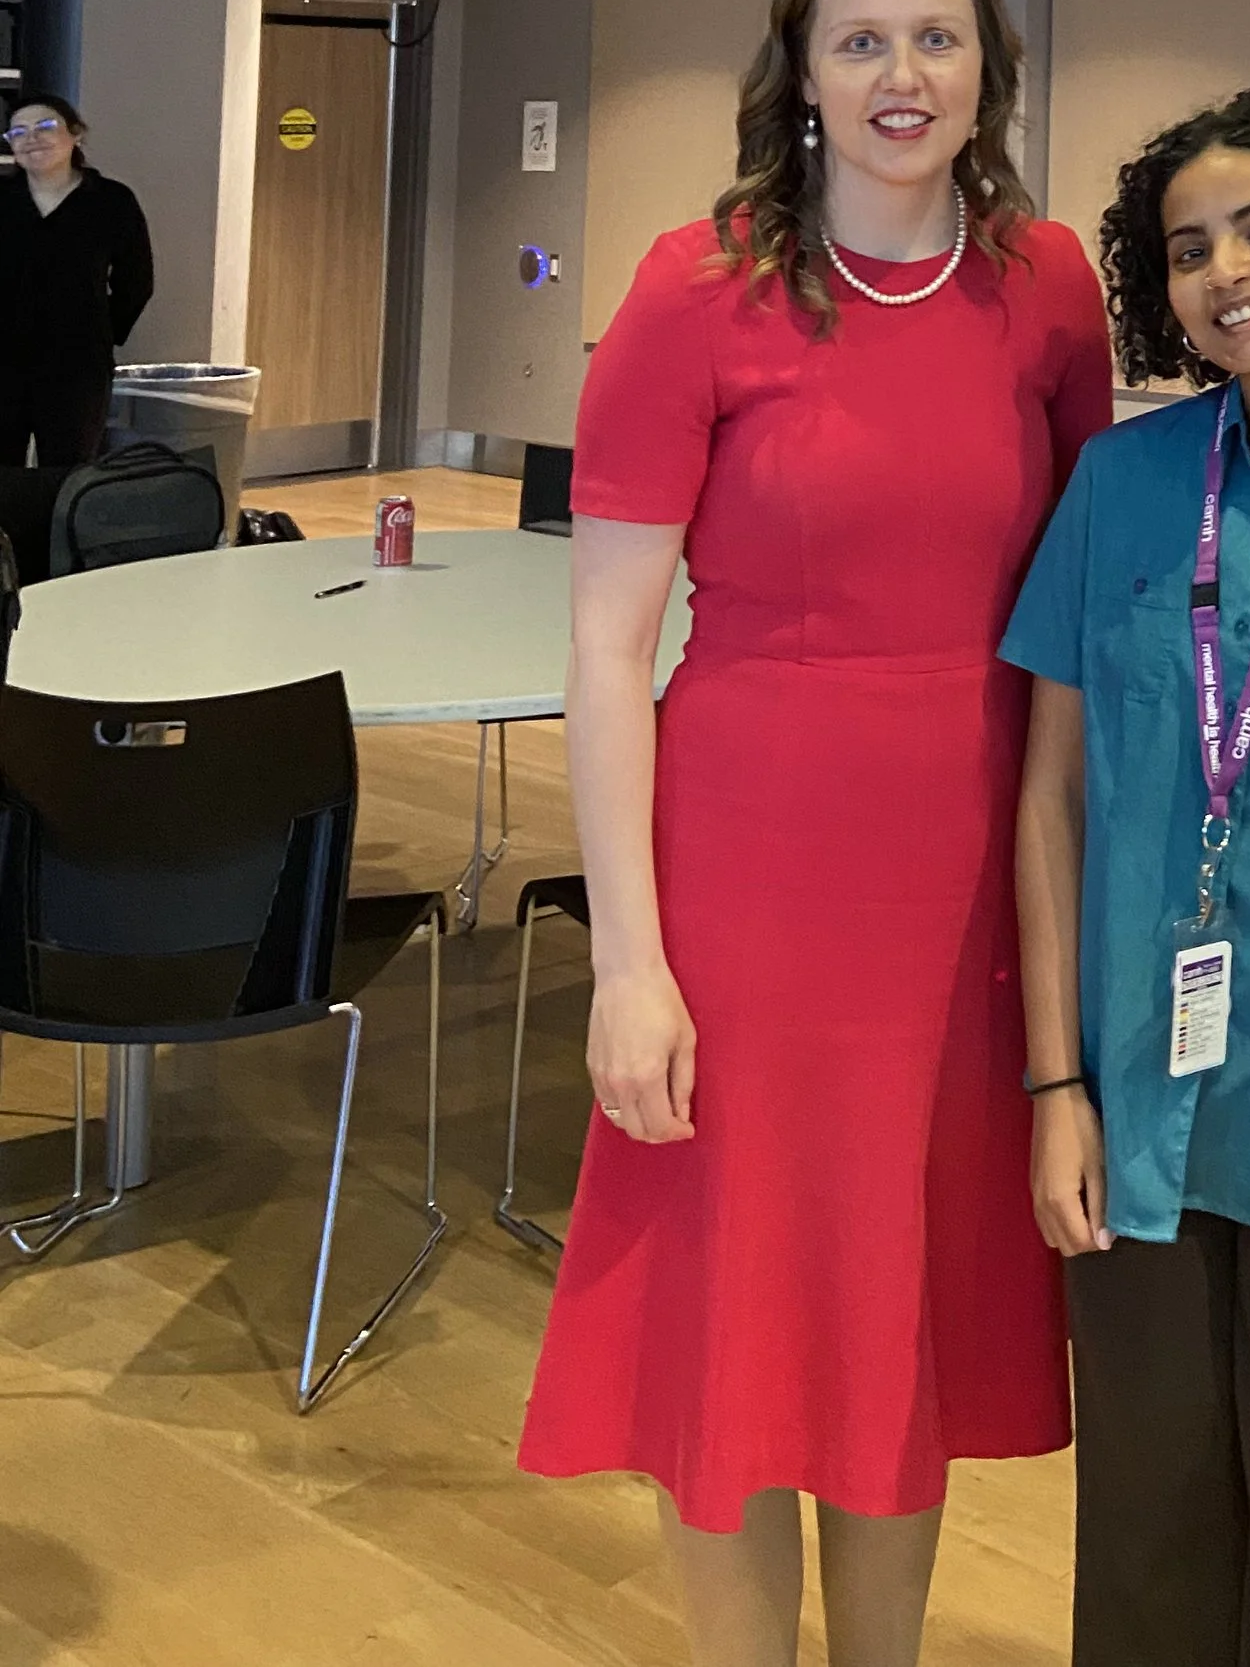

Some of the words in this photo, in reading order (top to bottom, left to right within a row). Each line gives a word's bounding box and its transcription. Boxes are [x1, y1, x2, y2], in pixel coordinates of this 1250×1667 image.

[1200, 493, 1216, 542] camh
[1201, 643, 1217, 685] mental
[1203, 686, 1219, 725] health
[1203, 725, 1221, 741] is
